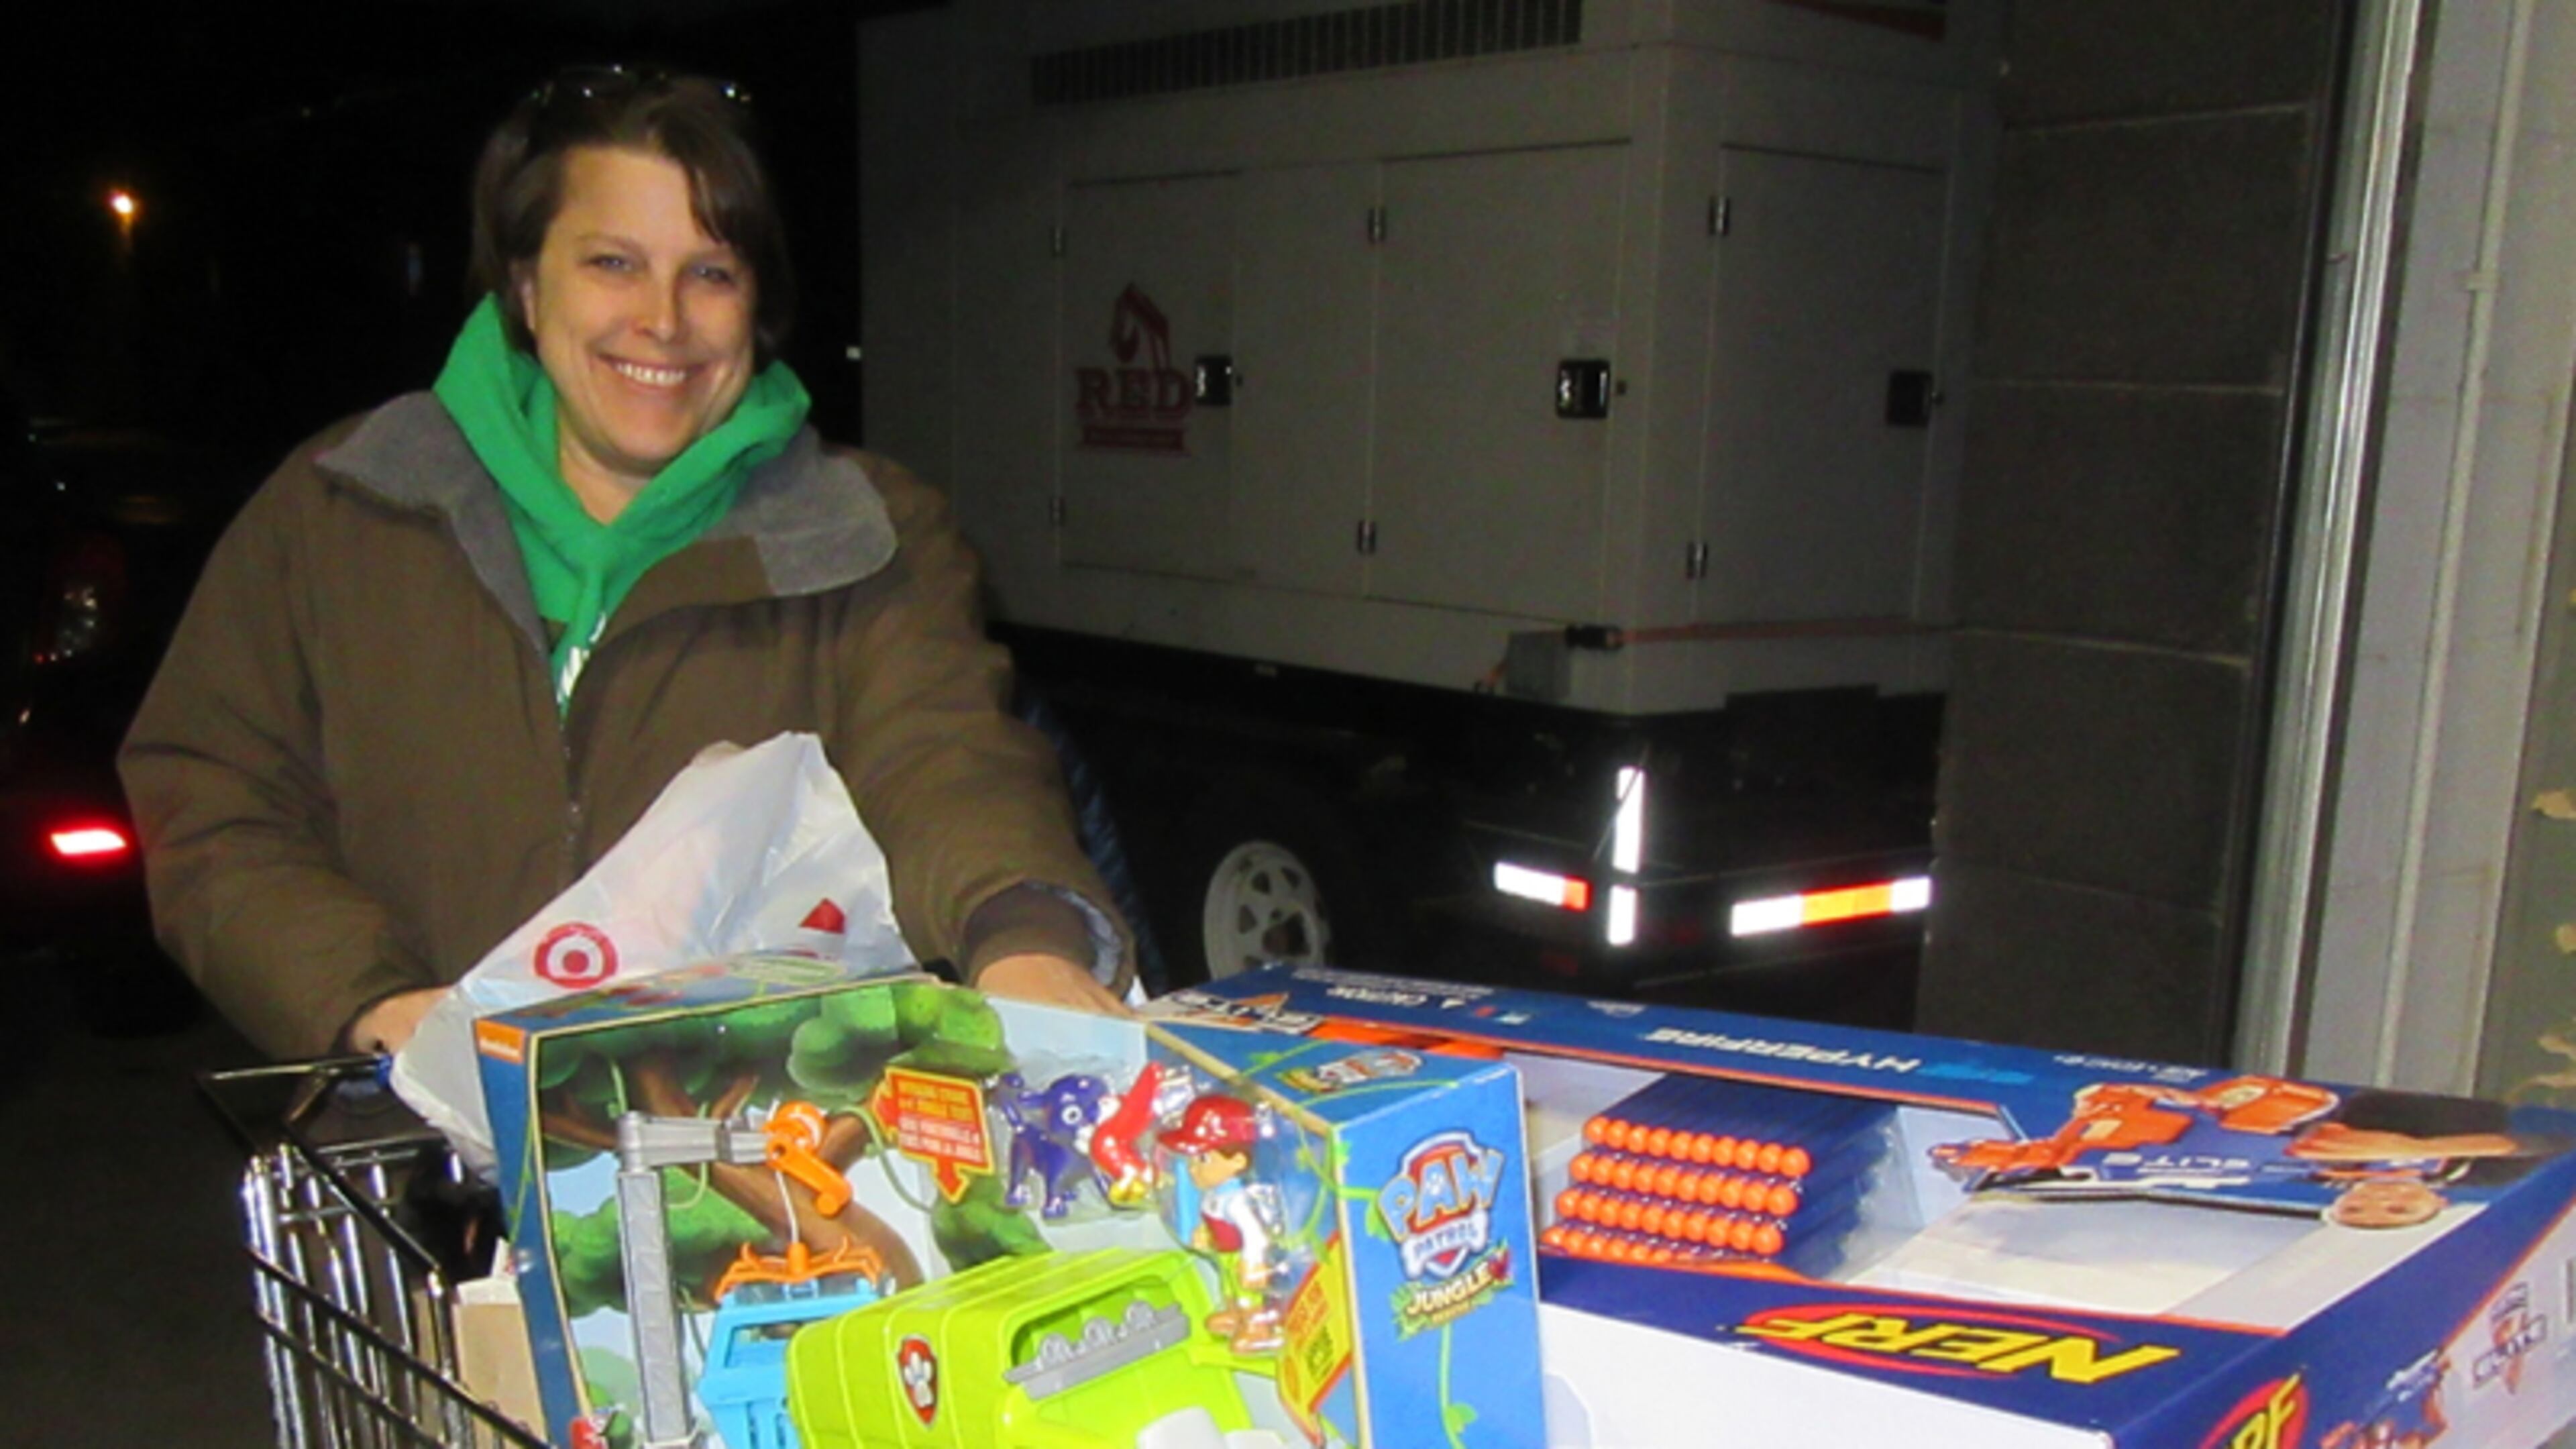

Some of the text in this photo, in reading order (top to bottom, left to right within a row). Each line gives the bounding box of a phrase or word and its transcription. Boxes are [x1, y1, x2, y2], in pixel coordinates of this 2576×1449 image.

[1075, 367, 1193, 420] RED
[1643, 1027, 1921, 1071] HYPERFIRE
[2102, 1152, 2250, 1169] ELITE
[1379, 1148, 1504, 1243] PAW
[1413, 1222, 1479, 1254] PATROL
[1406, 1260, 1492, 1316] JUNGLE
[1734, 1313, 2181, 1384] NERF
